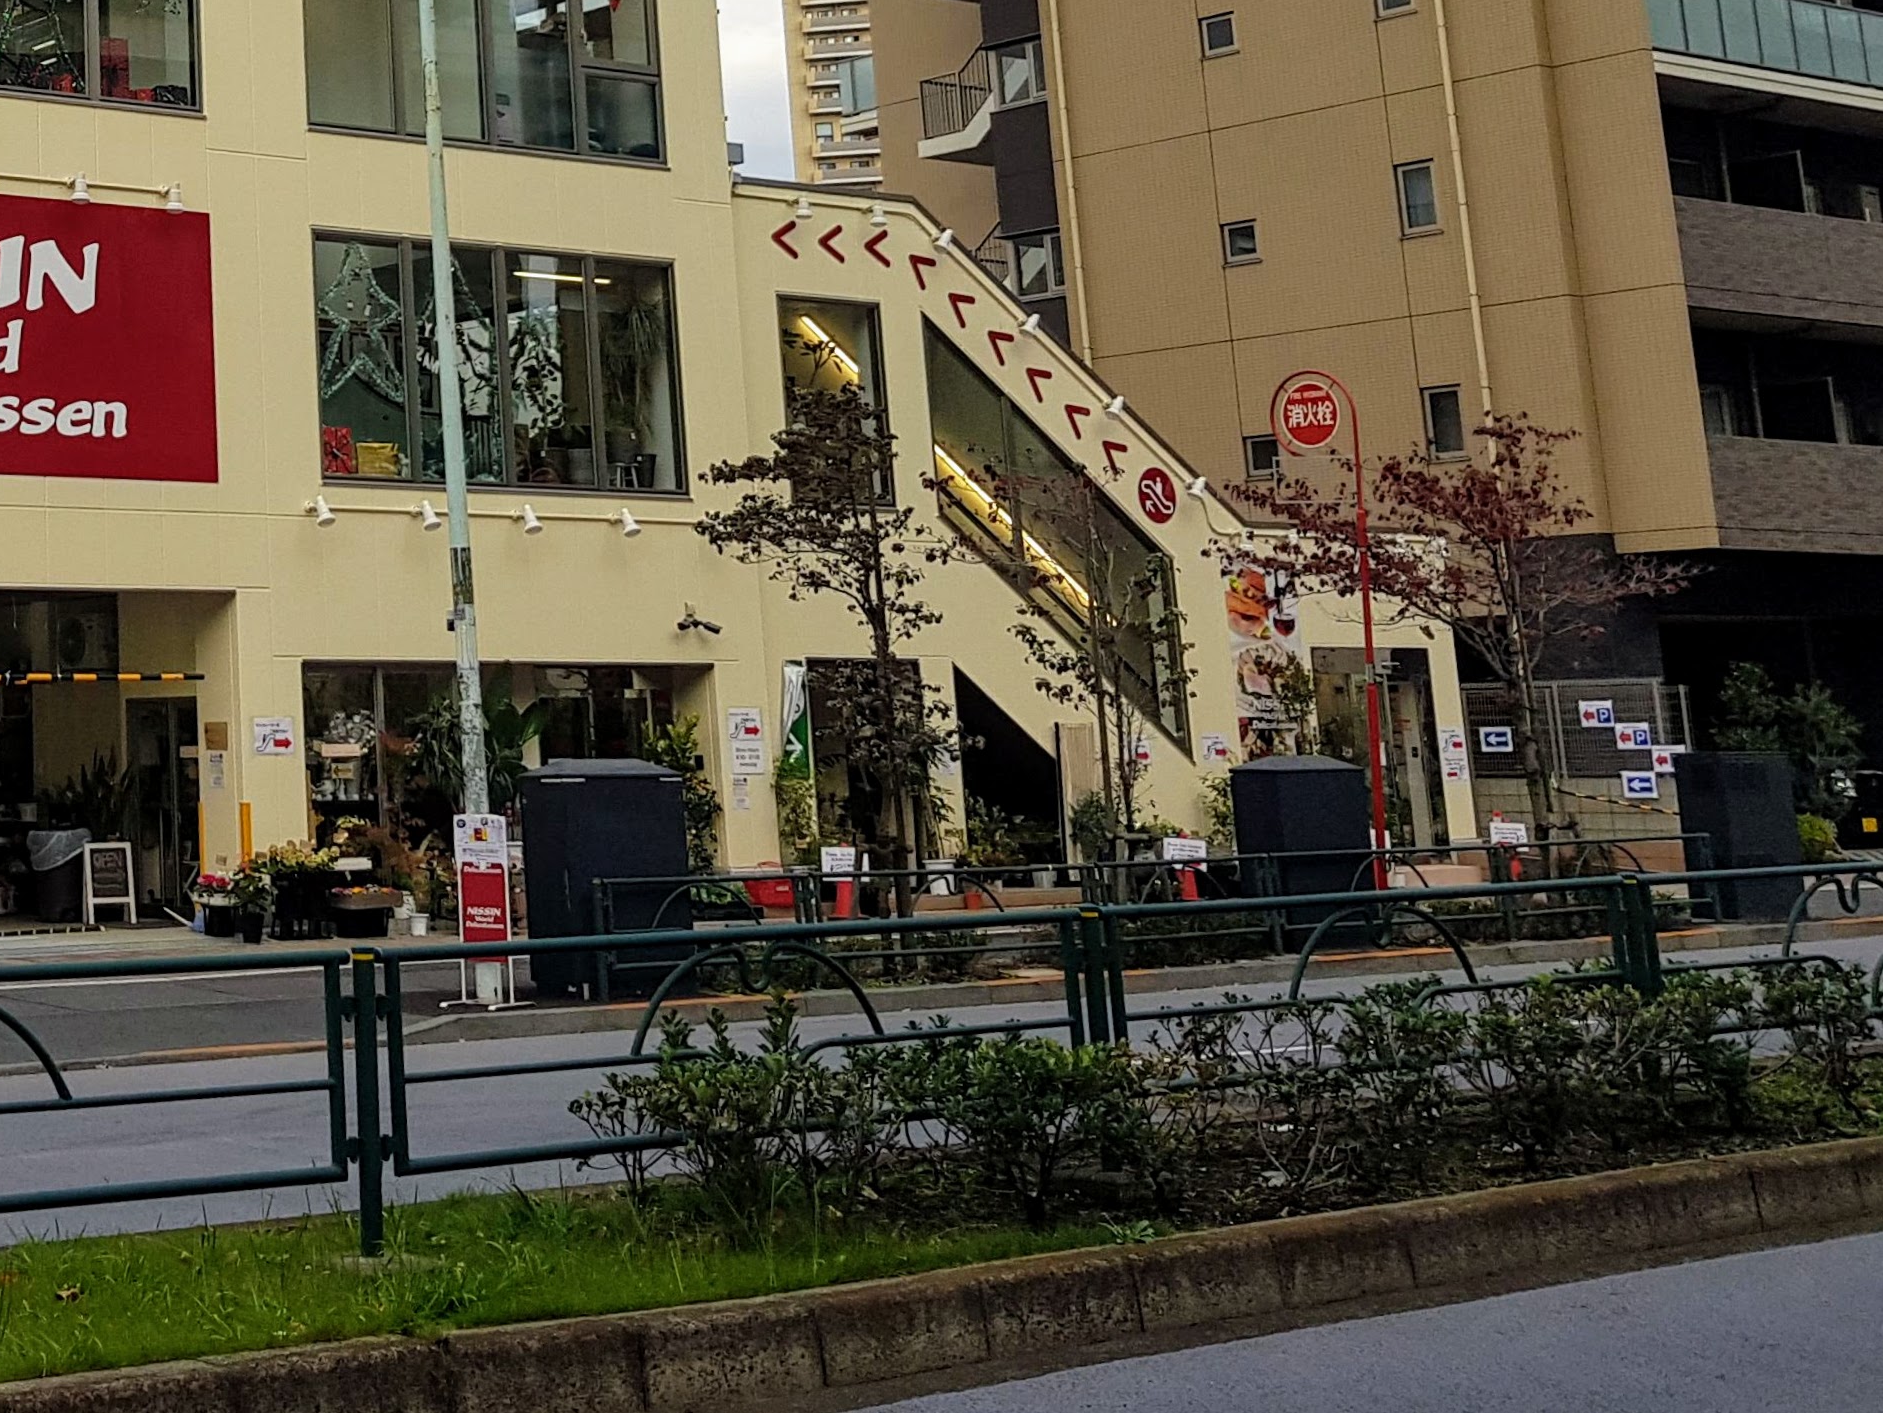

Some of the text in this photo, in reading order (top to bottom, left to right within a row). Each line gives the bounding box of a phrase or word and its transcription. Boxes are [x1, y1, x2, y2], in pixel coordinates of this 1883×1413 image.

[1287, 400, 1334, 428] 消火栓
[466, 907, 501, 917] NISSIN
